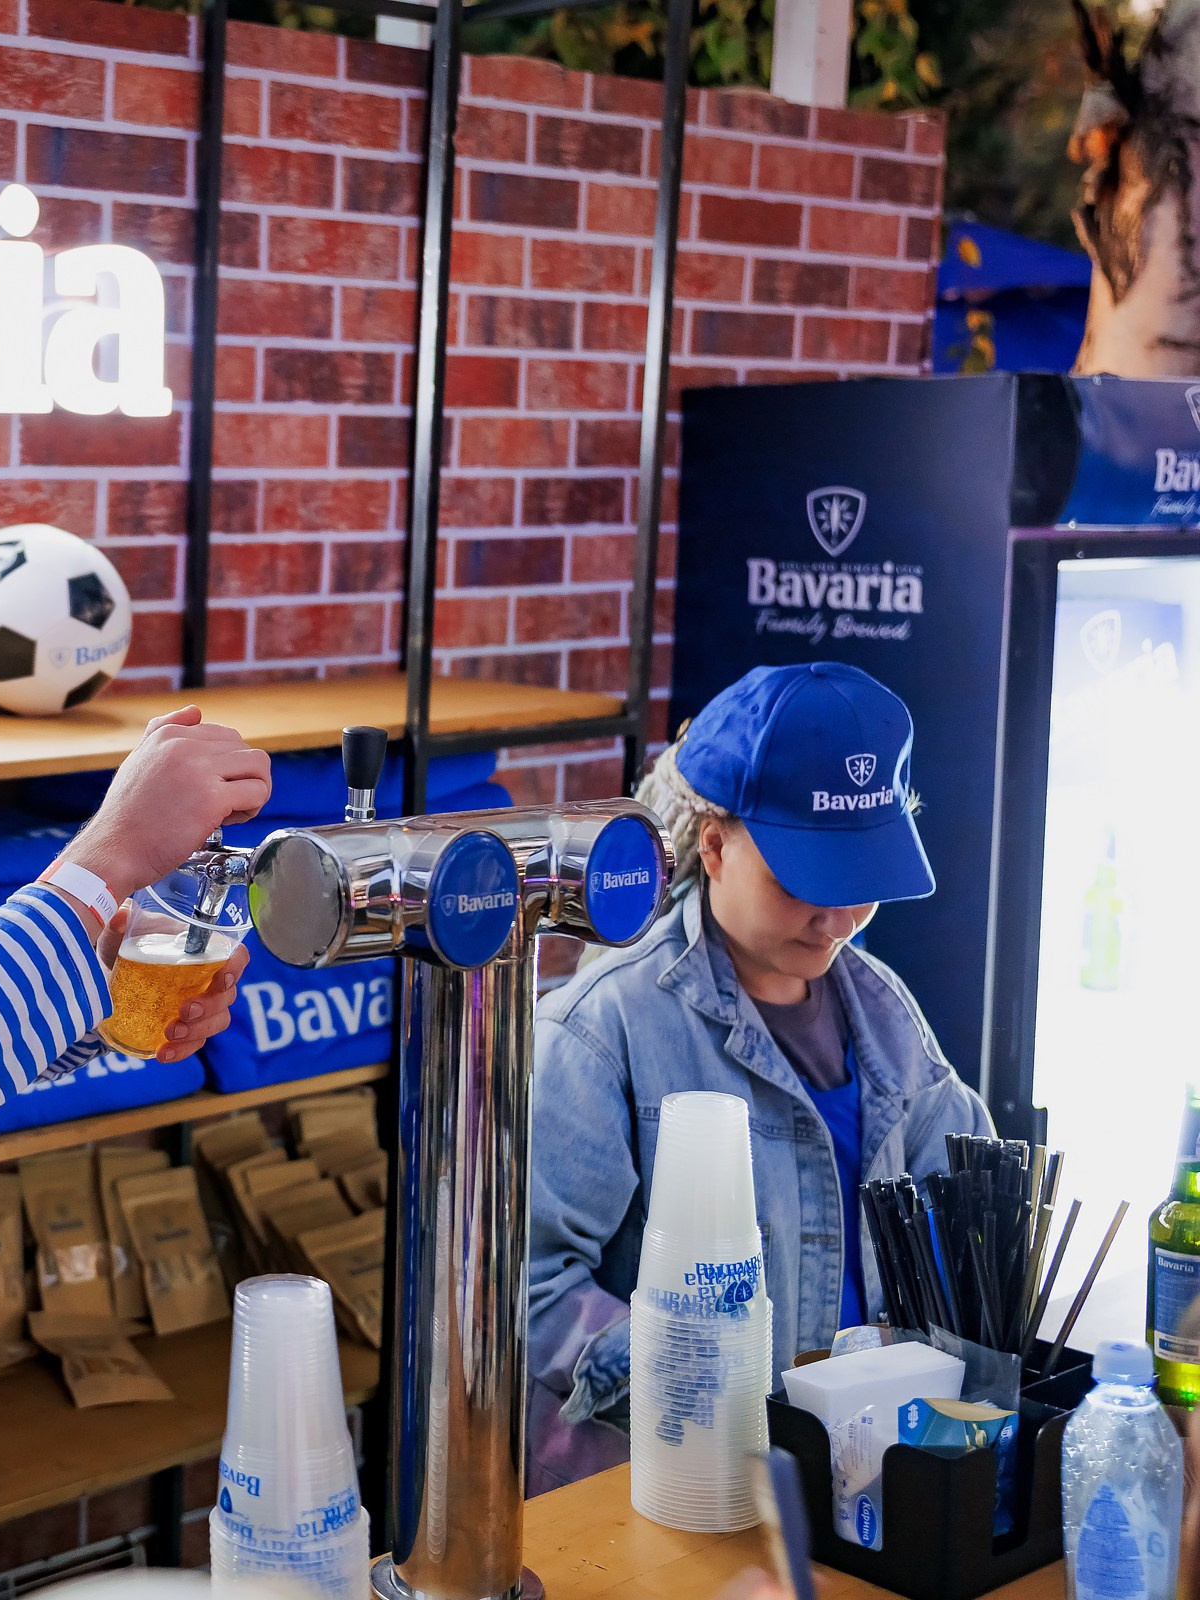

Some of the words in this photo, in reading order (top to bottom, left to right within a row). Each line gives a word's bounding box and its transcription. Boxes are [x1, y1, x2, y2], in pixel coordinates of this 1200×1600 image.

[747, 558, 923, 613] Bavaria
[812, 785, 894, 811] Bavaria
[603, 867, 649, 889] Bavaria
[458, 888, 514, 914] Bavaria
[1158, 1256, 1194, 1273] Bavaria
[861, 1501, 872, 1541] Карина
